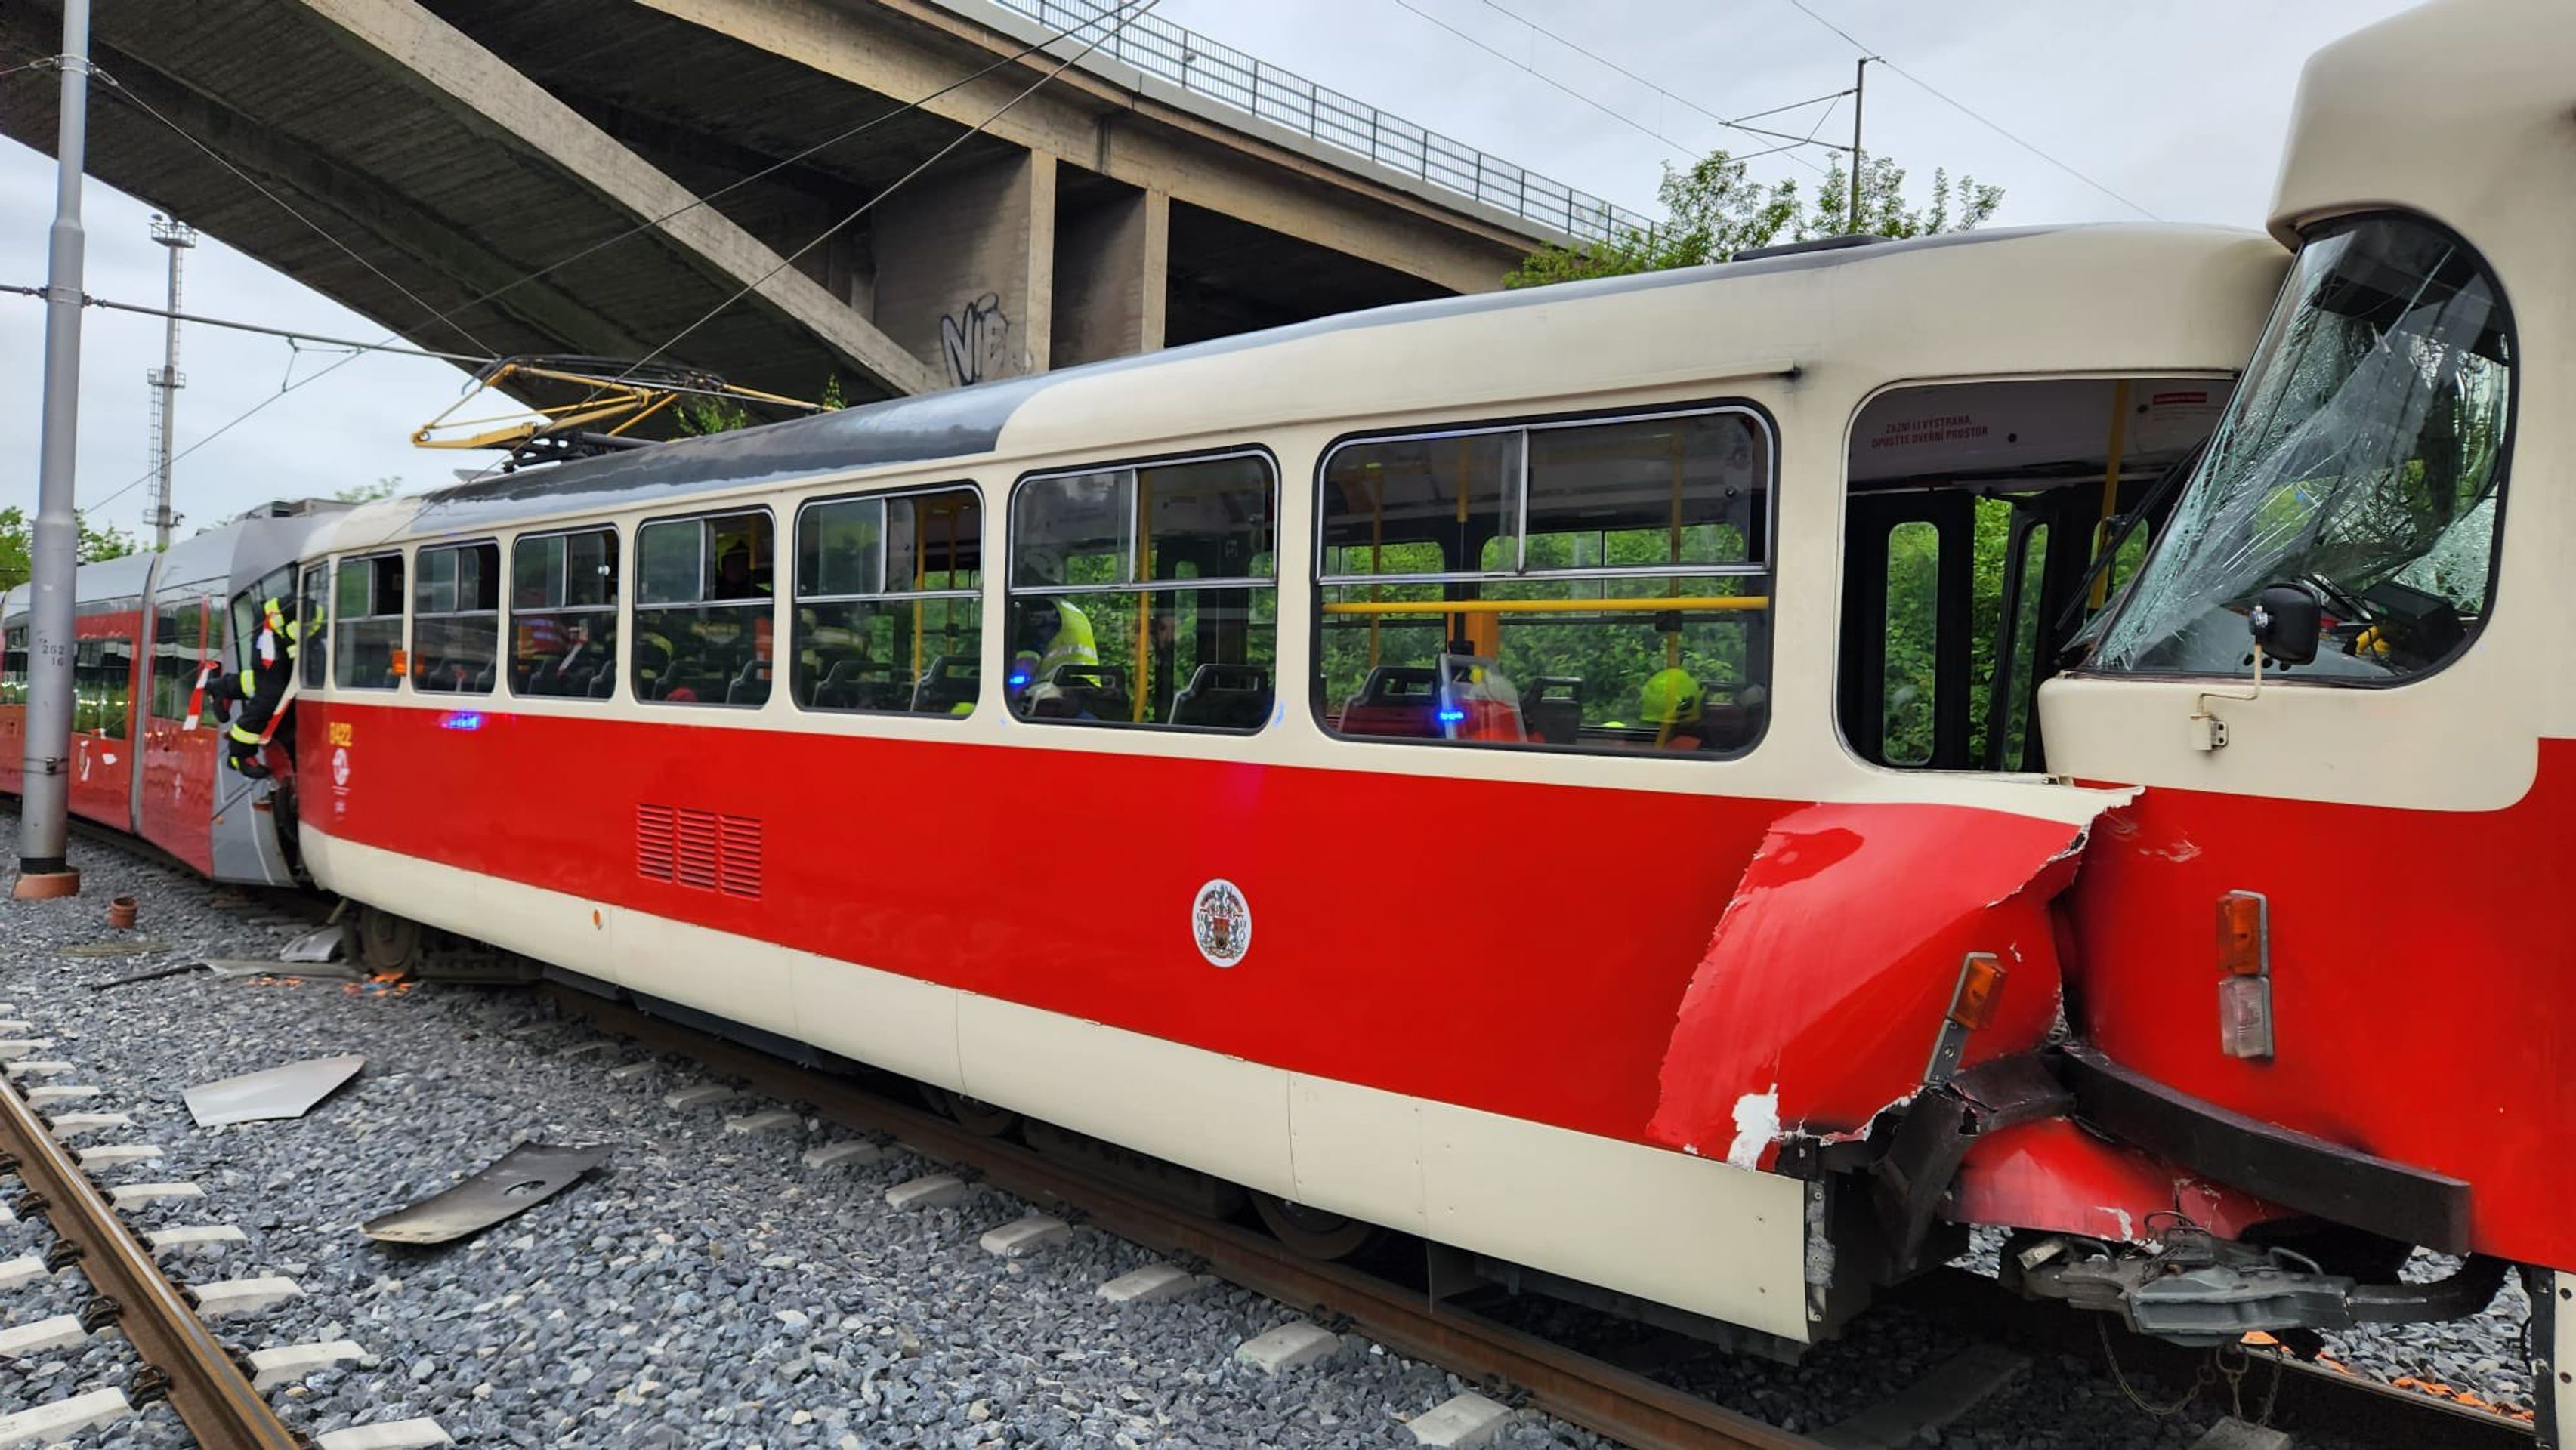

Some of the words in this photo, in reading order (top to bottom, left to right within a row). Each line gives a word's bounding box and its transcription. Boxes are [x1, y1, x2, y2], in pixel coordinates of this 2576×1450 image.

[1945, 426, 1989, 440] PROSTOR
[42, 644, 65, 656] 262
[52, 656, 64, 667] 16
